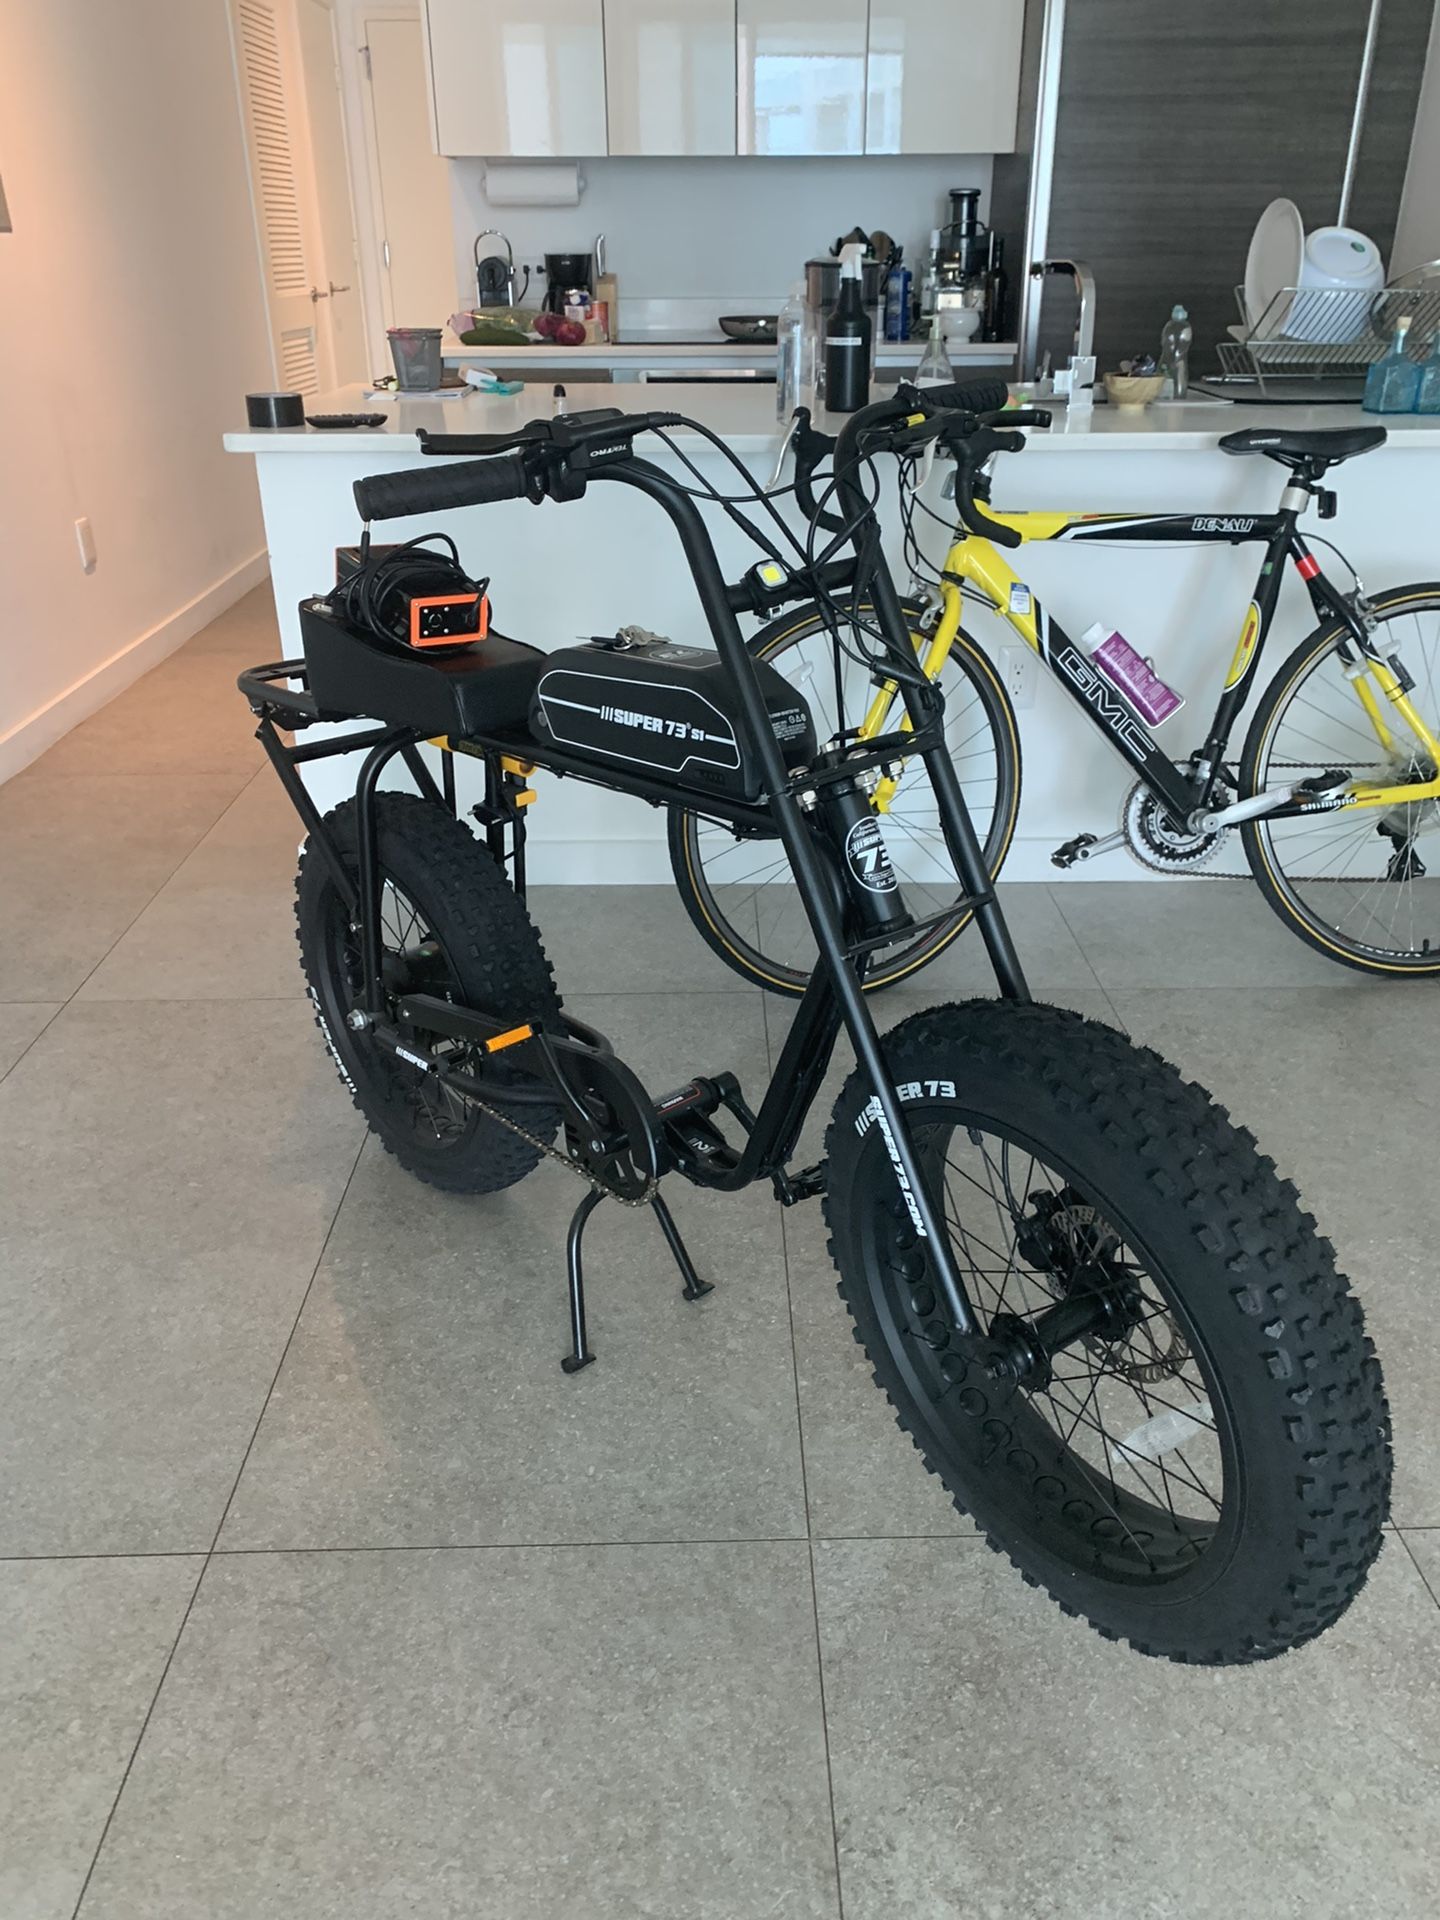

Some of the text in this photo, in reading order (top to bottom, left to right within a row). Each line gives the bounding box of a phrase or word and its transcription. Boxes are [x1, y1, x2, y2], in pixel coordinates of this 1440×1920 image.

[1191, 517, 1255, 533] DENALI
[1057, 647, 1156, 762] GMC
[613, 707, 664, 734] SUPER
[924, 1080, 957, 1098] 73
